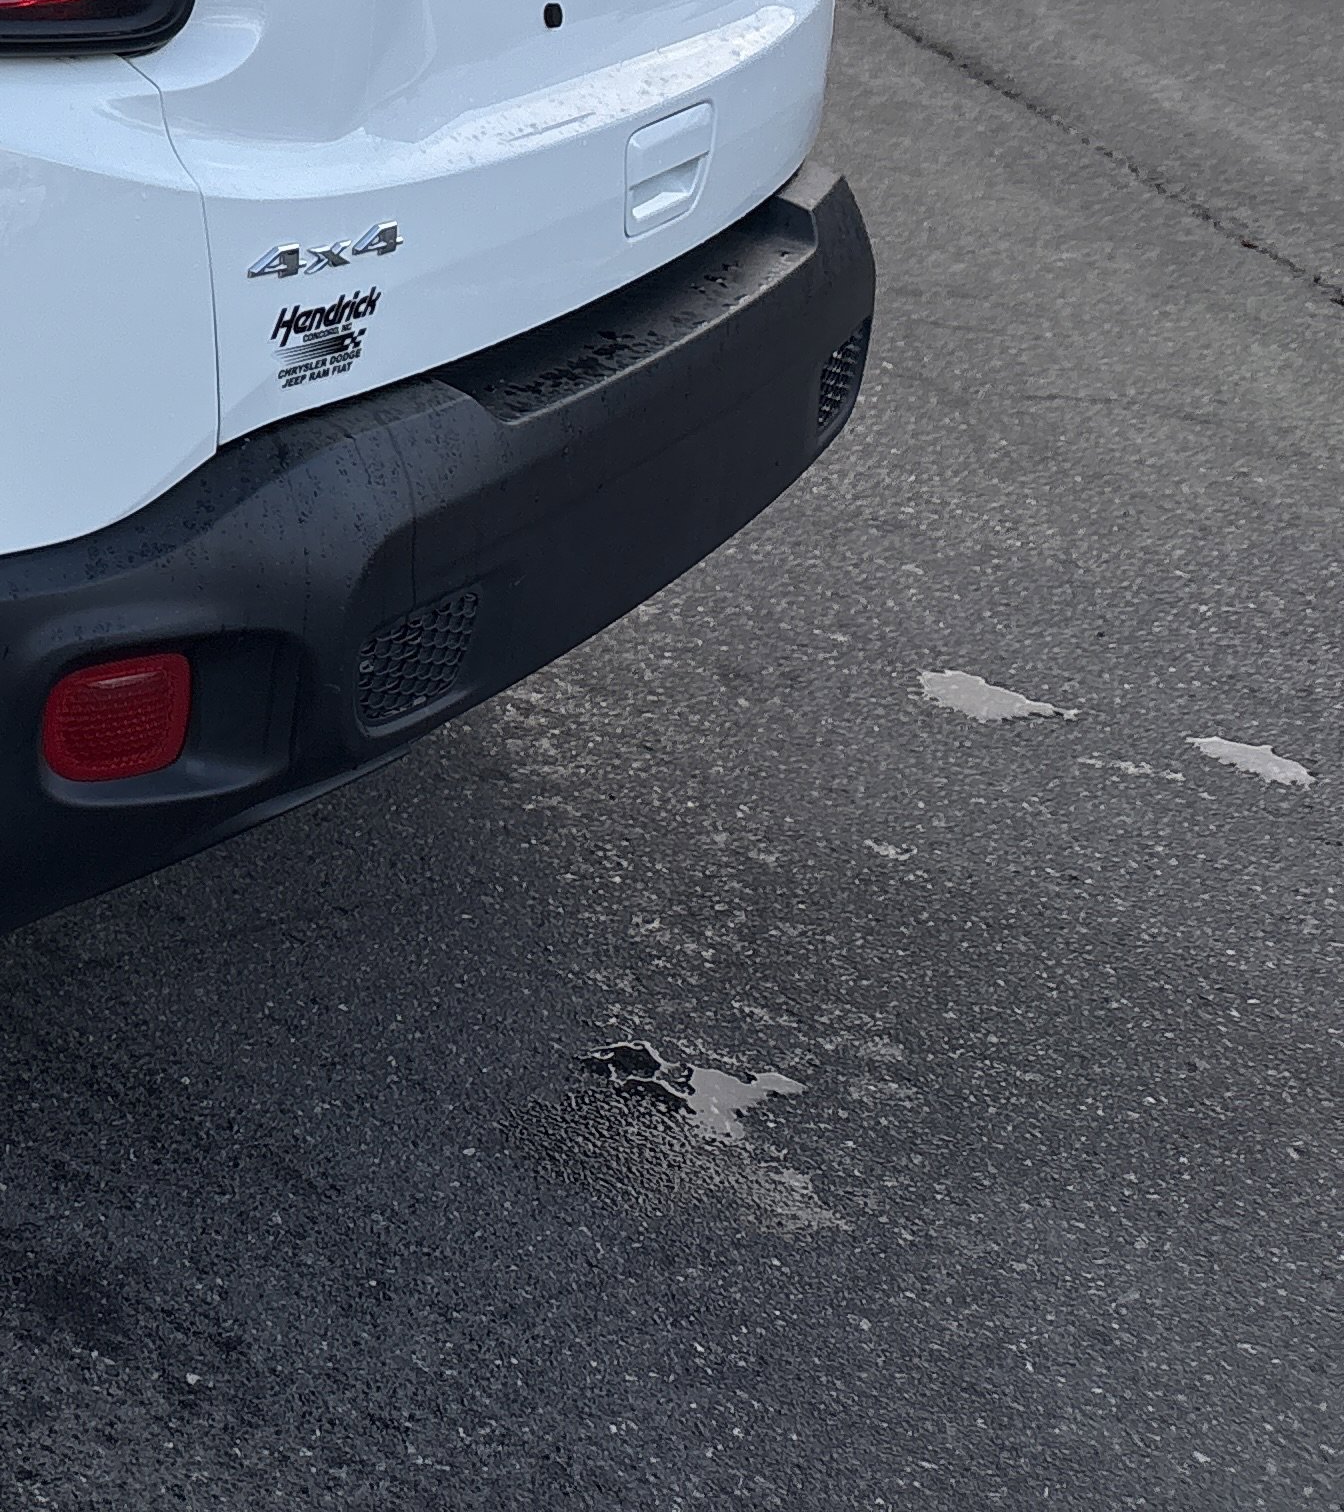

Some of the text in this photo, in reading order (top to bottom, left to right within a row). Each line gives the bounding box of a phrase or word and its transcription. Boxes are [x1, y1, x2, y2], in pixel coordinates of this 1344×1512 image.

[270, 286, 382, 348] Hendrick
[278, 348, 363, 380] CHRYSLER DODGE
[281, 361, 354, 389] JEEP RAM FIAT
